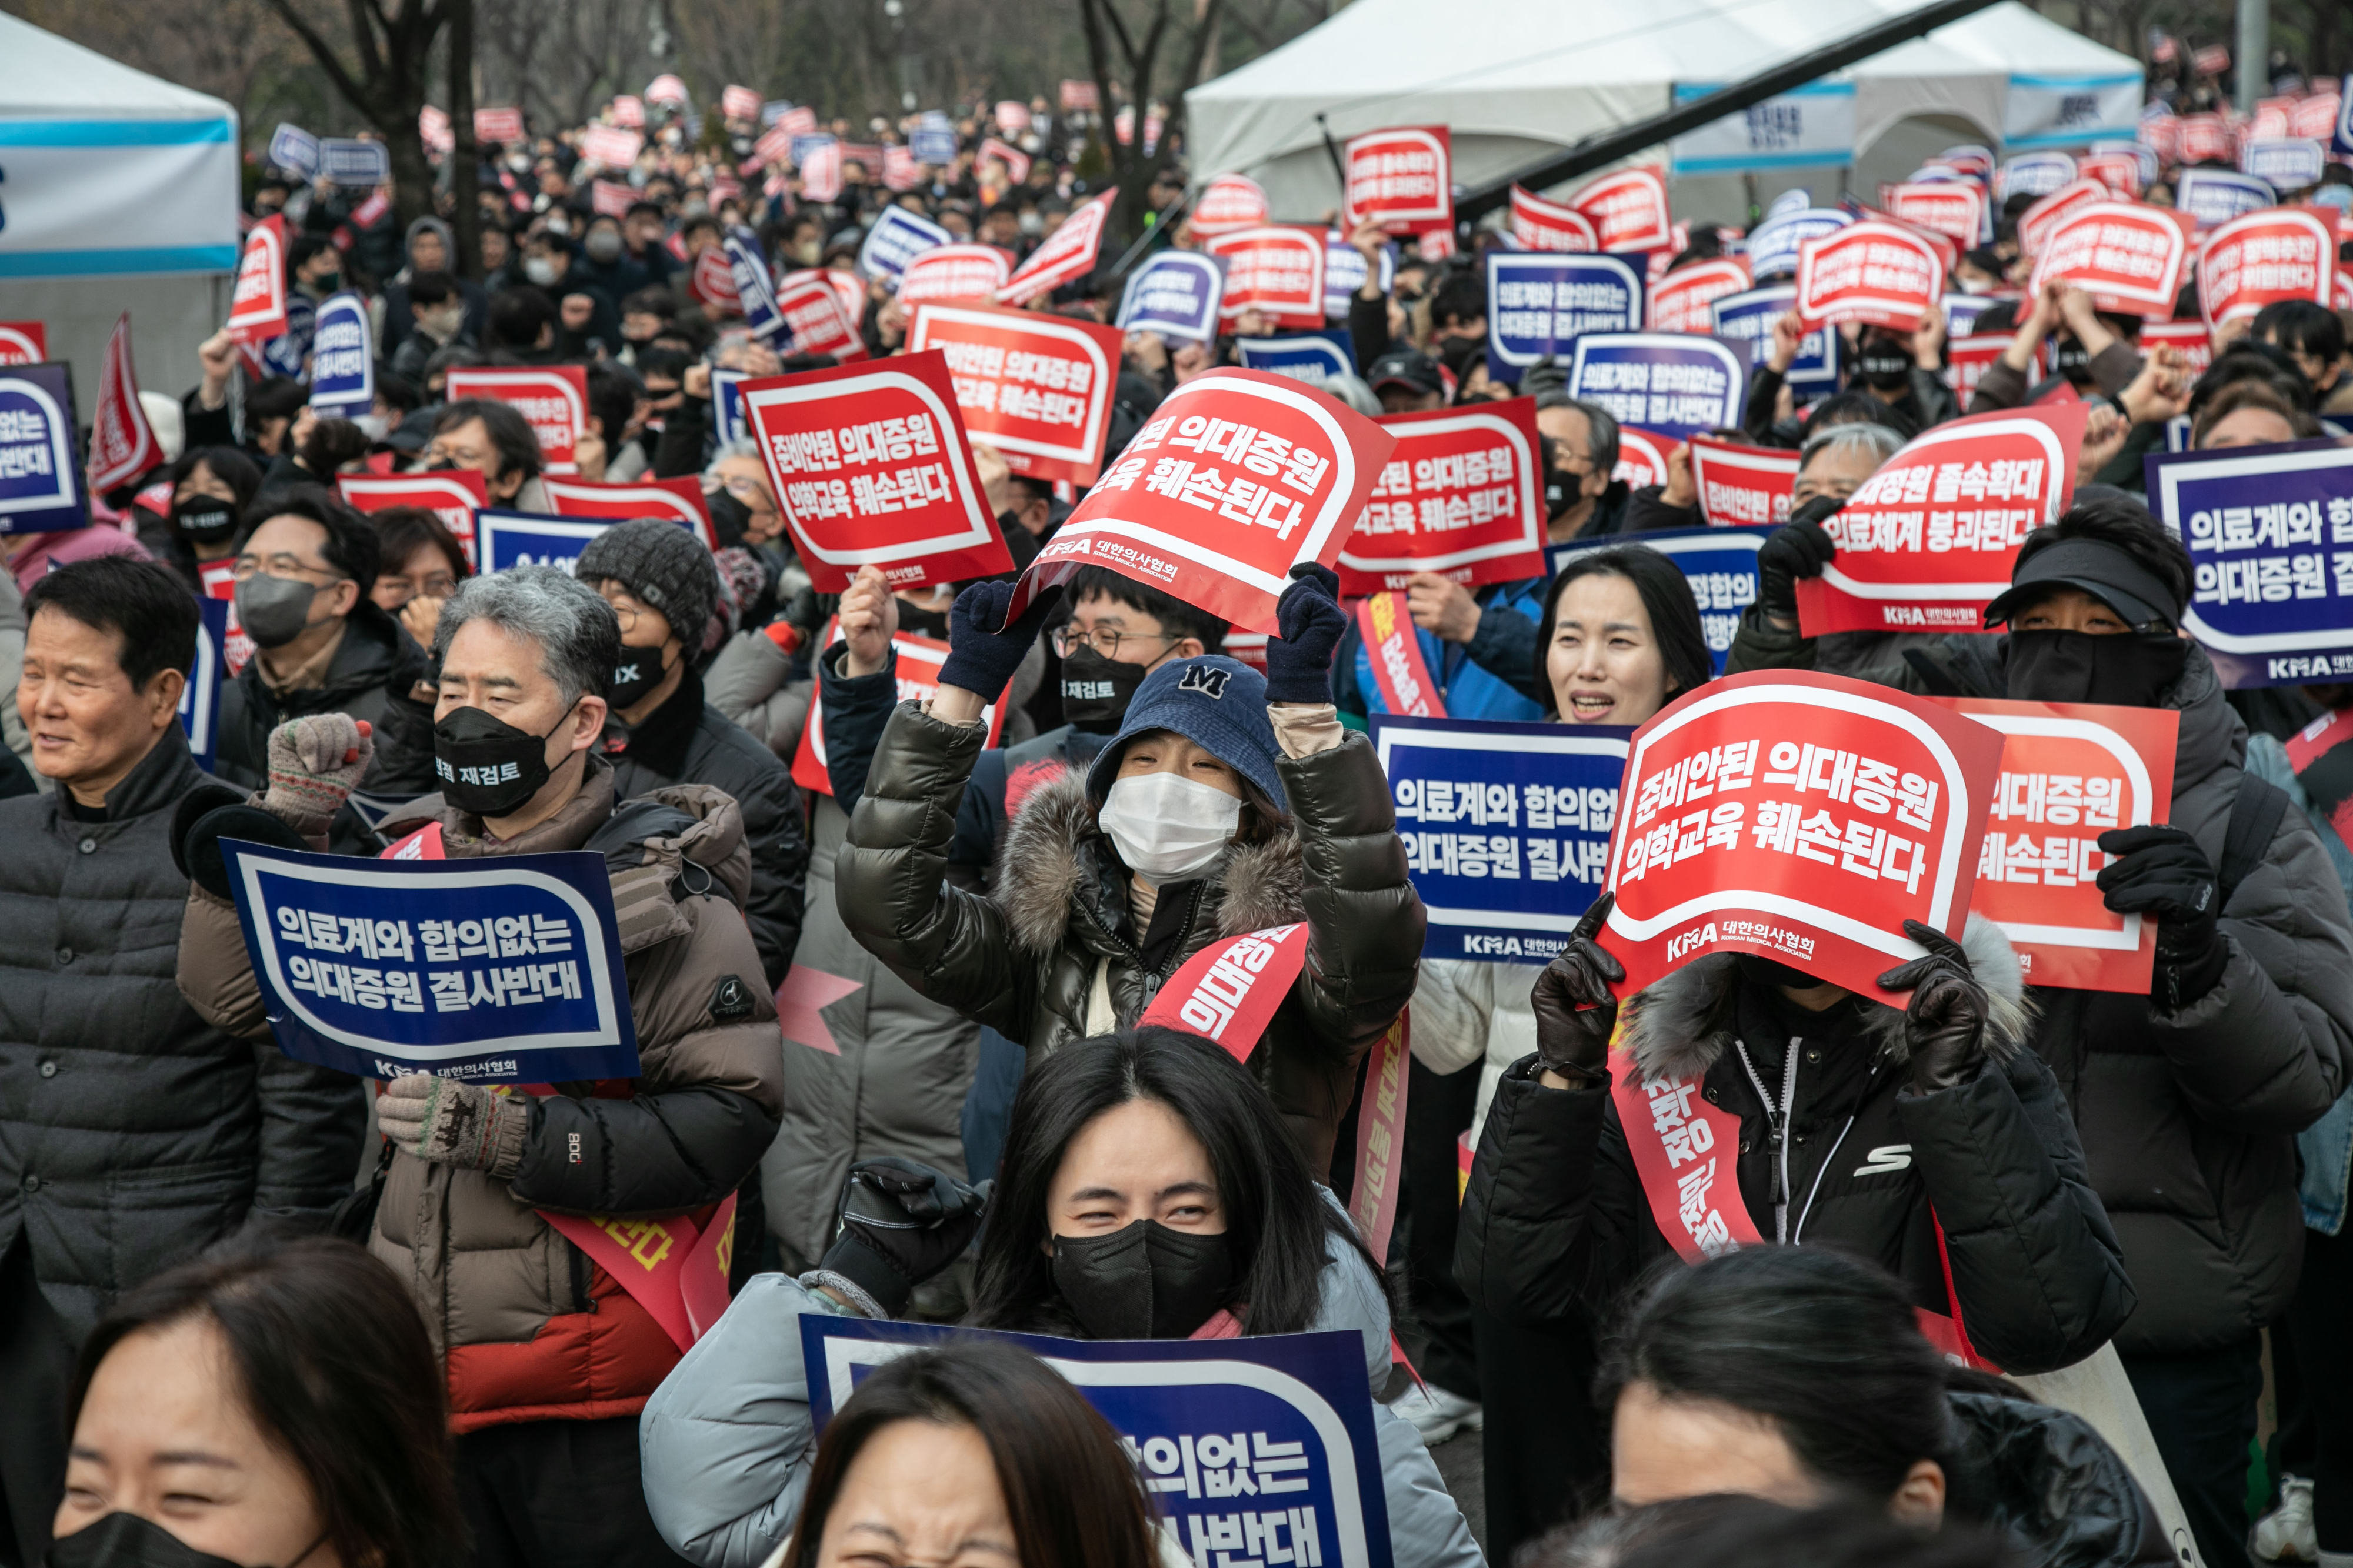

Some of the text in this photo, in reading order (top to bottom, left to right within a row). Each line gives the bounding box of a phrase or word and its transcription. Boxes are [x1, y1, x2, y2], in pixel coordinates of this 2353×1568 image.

[1004, 350, 1092, 394] 의대증원
[0, 409, 46, 441] 없는
[951, 377, 1086, 429] 교육 훼손된다
[0, 443, 52, 479] 반대
[771, 412, 939, 474] 준비안된 의대증원
[1169, 414, 1330, 496] 의대증원
[787, 462, 954, 521] 의학교육 훼손된다
[1415, 446, 1514, 492] 의대증원
[1933, 458, 2045, 502] 졸속확대
[1145, 456, 1305, 541] 훼손된다
[1353, 486, 1517, 536] 학교육 훼손된다
[1706, 480, 1770, 523] 준비안된
[1827, 508, 2036, 554] 의료체계 붕괴된다
[2189, 501, 2324, 553] 의료계와
[1092, 550, 1174, 583] KOREAN MEDICAL ASSOCIATION
[1096, 539, 1178, 578] 대한의사협회
[2193, 553, 2328, 606] 의대증원
[1686, 572, 1756, 610] 정합의
[1883, 605, 1927, 625] KMA
[1067, 679, 1116, 700] 재검토
[1178, 664, 1232, 700] M
[2268, 655, 2333, 679] KMA
[459, 760, 522, 786] 재검토
[1635, 739, 1940, 833] 준비안된 의대증원
[1395, 779, 1619, 832] 의료계와 합의없
[1989, 770, 2122, 828] 의대증원
[1400, 831, 1522, 880] 의대증원
[1620, 799, 1927, 896] 의학교육 훼손된다
[276, 905, 573, 963] 의료계와 합의없는
[1464, 933, 1523, 956] KMA
[1524, 938, 1569, 954] 대한의사
[1667, 922, 1718, 963] KMA
[1722, 920, 1815, 955] 대한의사협회
[1745, 936, 1773, 948] MEDICAL
[1773, 943, 1812, 962] ASSOCIATION
[288, 955, 584, 1014] 의대증원 결사반대
[437, 1059, 518, 1079] 대한의사협회
[1678, 1156, 1741, 1262] 방적인
[1161, 1505, 1324, 1568] 사반대
